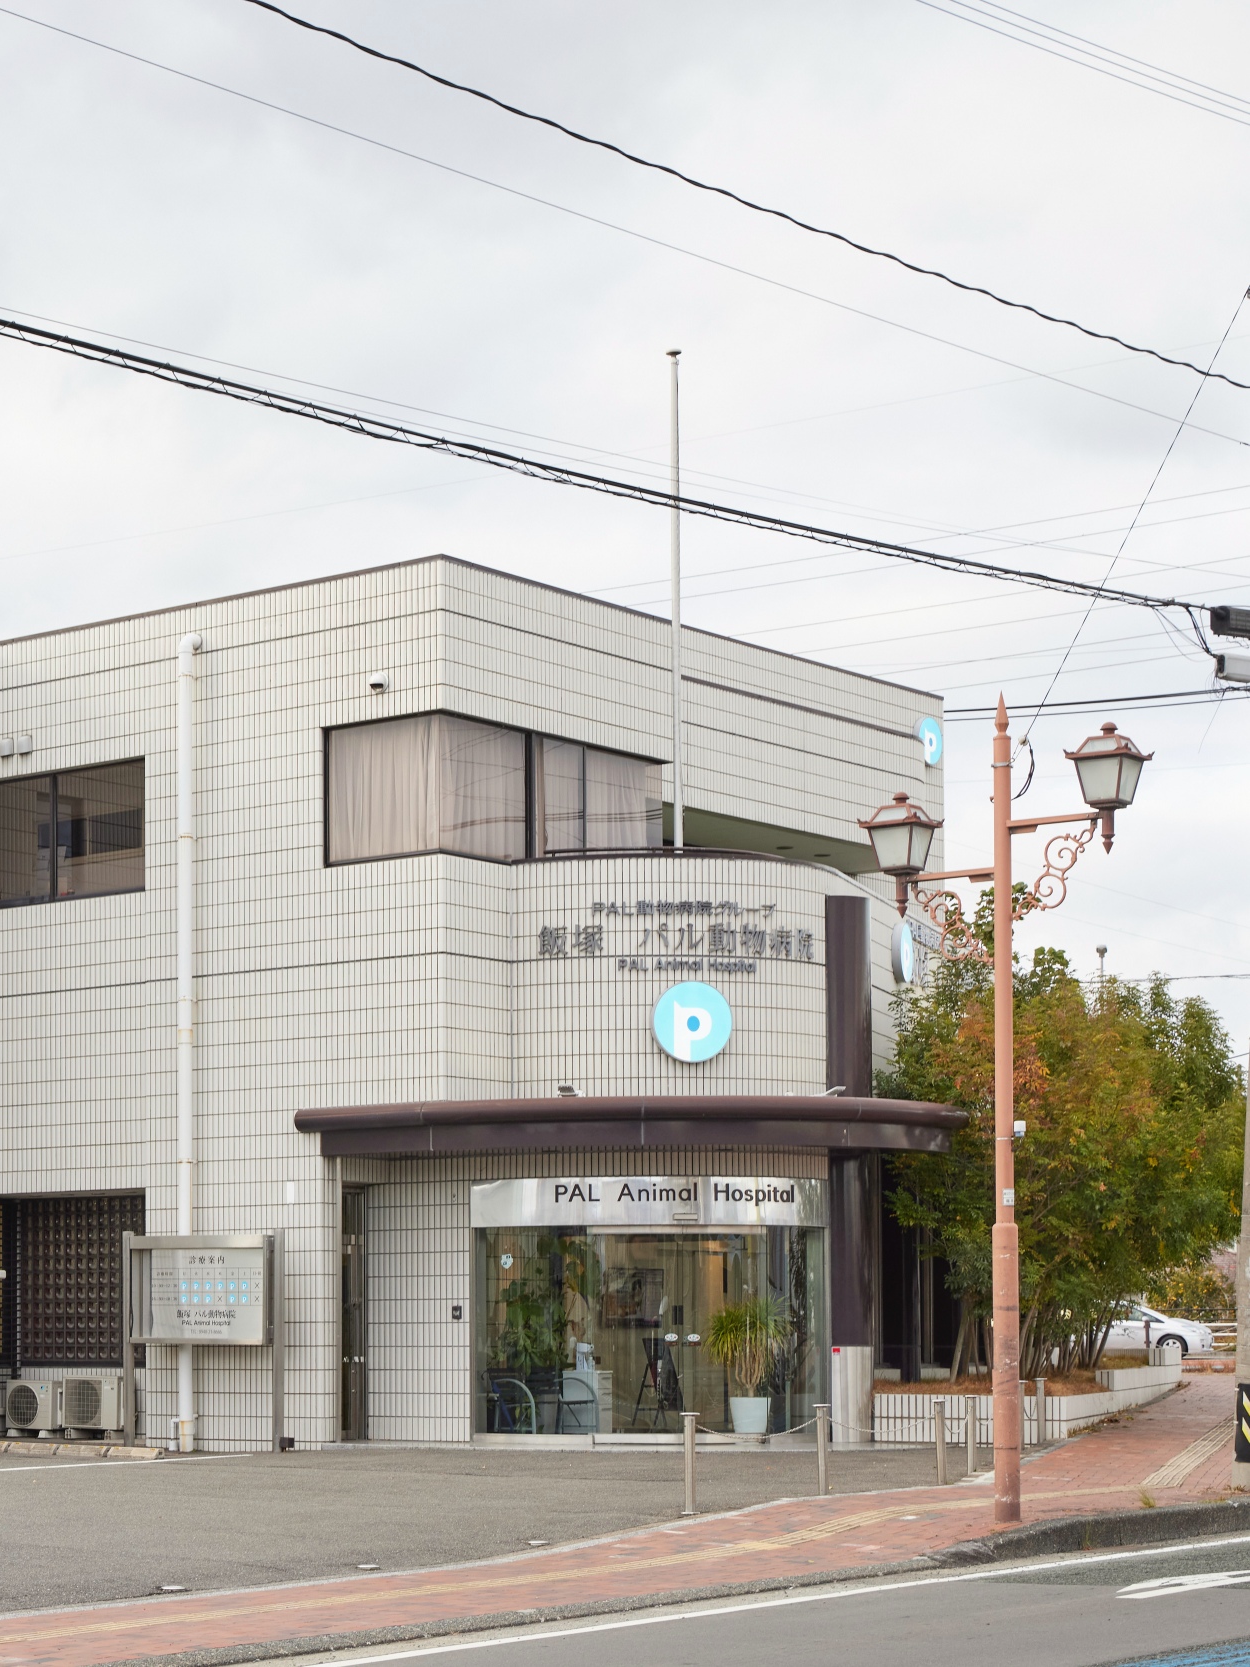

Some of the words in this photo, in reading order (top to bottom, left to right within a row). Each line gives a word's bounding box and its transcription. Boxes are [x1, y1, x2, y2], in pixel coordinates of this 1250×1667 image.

[591, 900, 776, 918] PAL動物病院グループ
[538, 924, 604, 956] 飯塚
[638, 922, 815, 960] パル動物病院
[617, 958, 649, 972] PAL
[654, 958, 703, 972] Animal
[707, 958, 757, 974] Hospital
[554, 1183, 601, 1203] PAL
[617, 1182, 698, 1202] Animal
[713, 1183, 795, 1207] Hospital
[211, 1319, 231, 1327] Hospital
